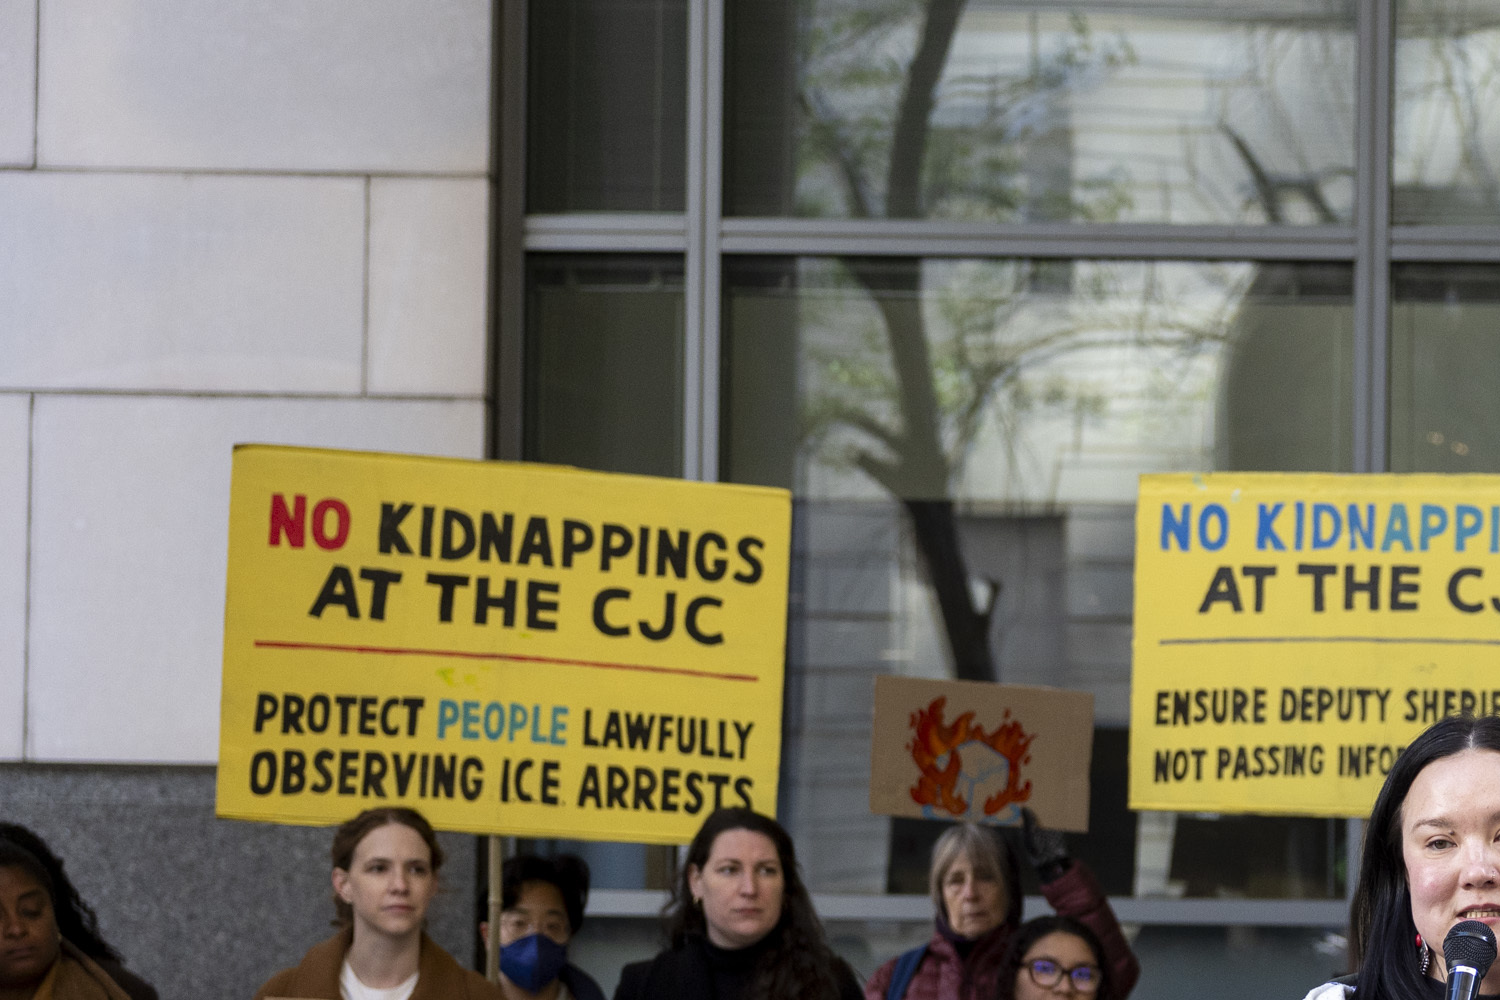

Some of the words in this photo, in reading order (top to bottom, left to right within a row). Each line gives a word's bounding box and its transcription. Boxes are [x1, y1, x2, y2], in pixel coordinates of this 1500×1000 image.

[267, 492, 351, 552] NO
[377, 501, 767, 586] KIDNAPPINGS
[1158, 501, 1231, 552] NO
[307, 564, 403, 622] AT
[425, 572, 561, 632] THE
[591, 586, 726, 646] CJC
[1198, 564, 1278, 615] AT
[1296, 563, 1422, 614] THE
[252, 691, 426, 738] PROTECT
[436, 698, 570, 747] PEOPLE
[582, 707, 755, 761] LAWFULLY
[1154, 687, 1268, 727] ENSURE
[1280, 686, 1392, 724] DEPUTY
[249, 749, 485, 803] OBSERVING
[576, 763, 755, 815] ARRESTS
[1153, 748, 1207, 784] NOT
[1216, 745, 1325, 782] PASSING
[1337, 743, 1407, 779] INFO
